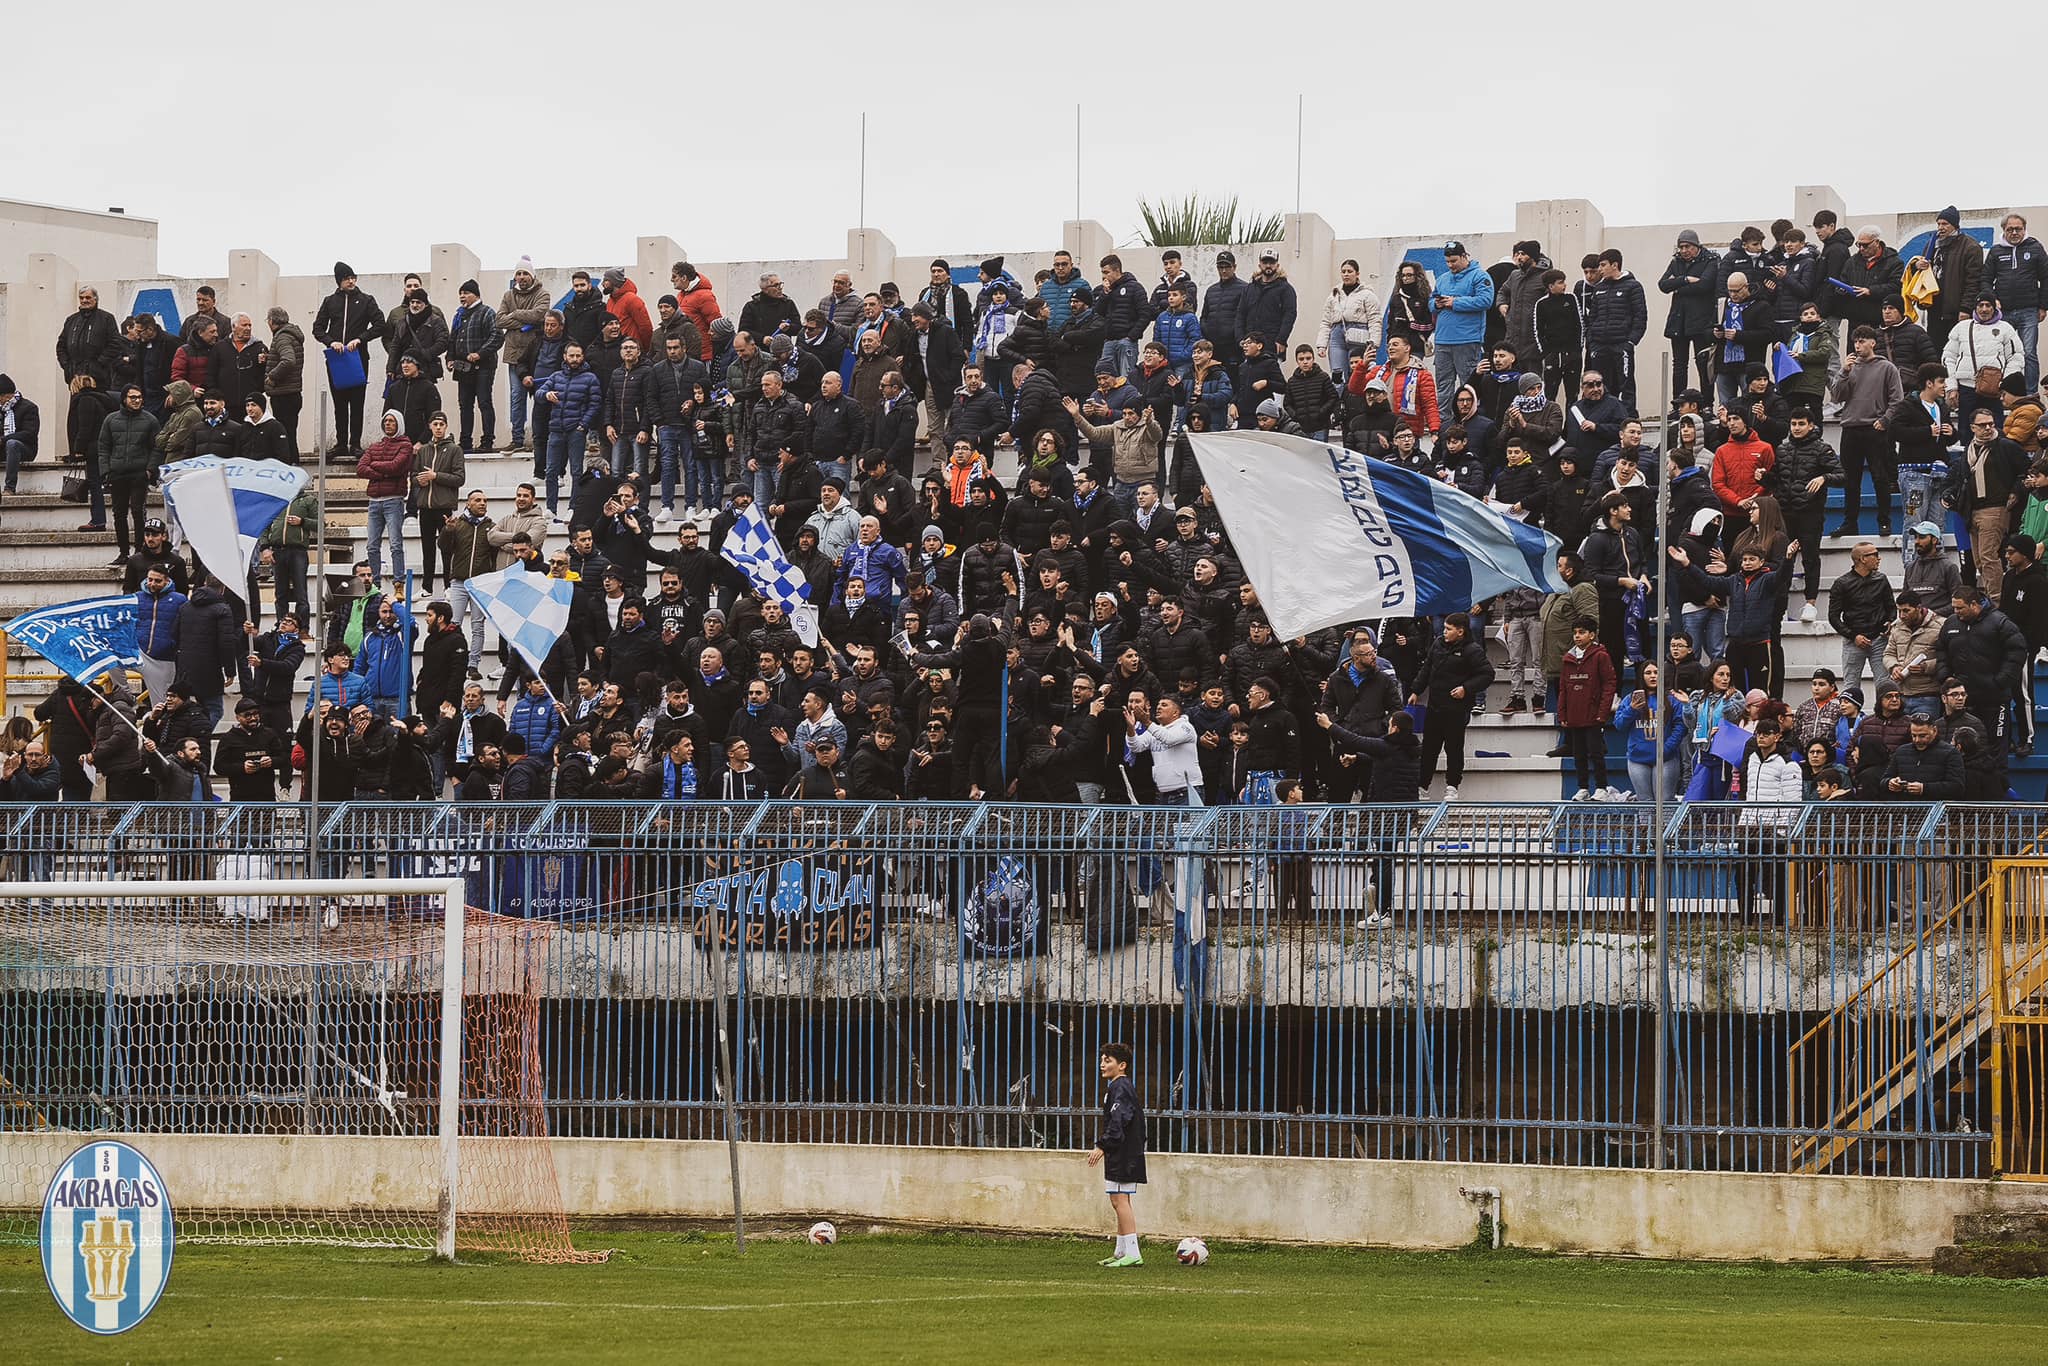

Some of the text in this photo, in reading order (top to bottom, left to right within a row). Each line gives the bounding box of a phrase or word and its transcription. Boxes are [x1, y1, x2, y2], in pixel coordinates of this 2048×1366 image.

[1996, 705, 2006, 737] GIVOV
[812, 866, 873, 914] CLAN
[693, 910, 873, 945] AKRAGAS
